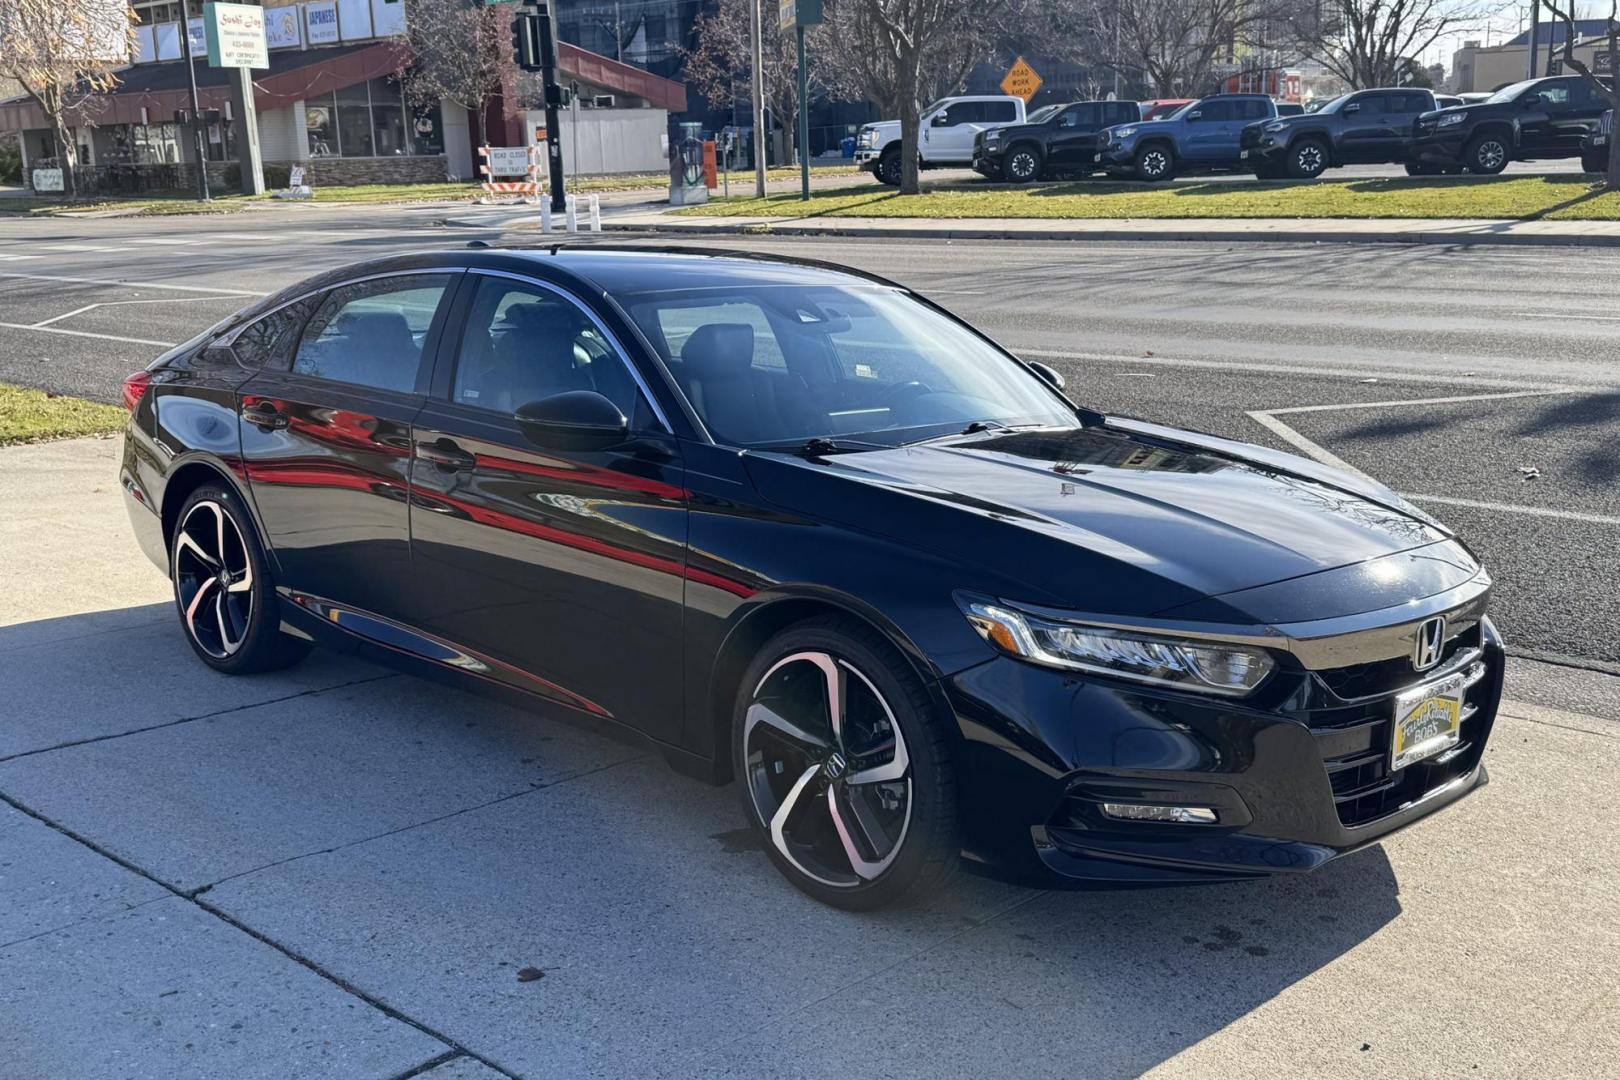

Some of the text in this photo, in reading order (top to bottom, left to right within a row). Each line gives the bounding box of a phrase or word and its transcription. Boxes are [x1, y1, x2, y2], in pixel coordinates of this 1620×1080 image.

[220, 14, 262, 29] Sushi Joy
[309, 9, 336, 24] JAPANESE
[1012, 79, 1029, 87] WORK
[510, 151, 526, 159] CLOSED
